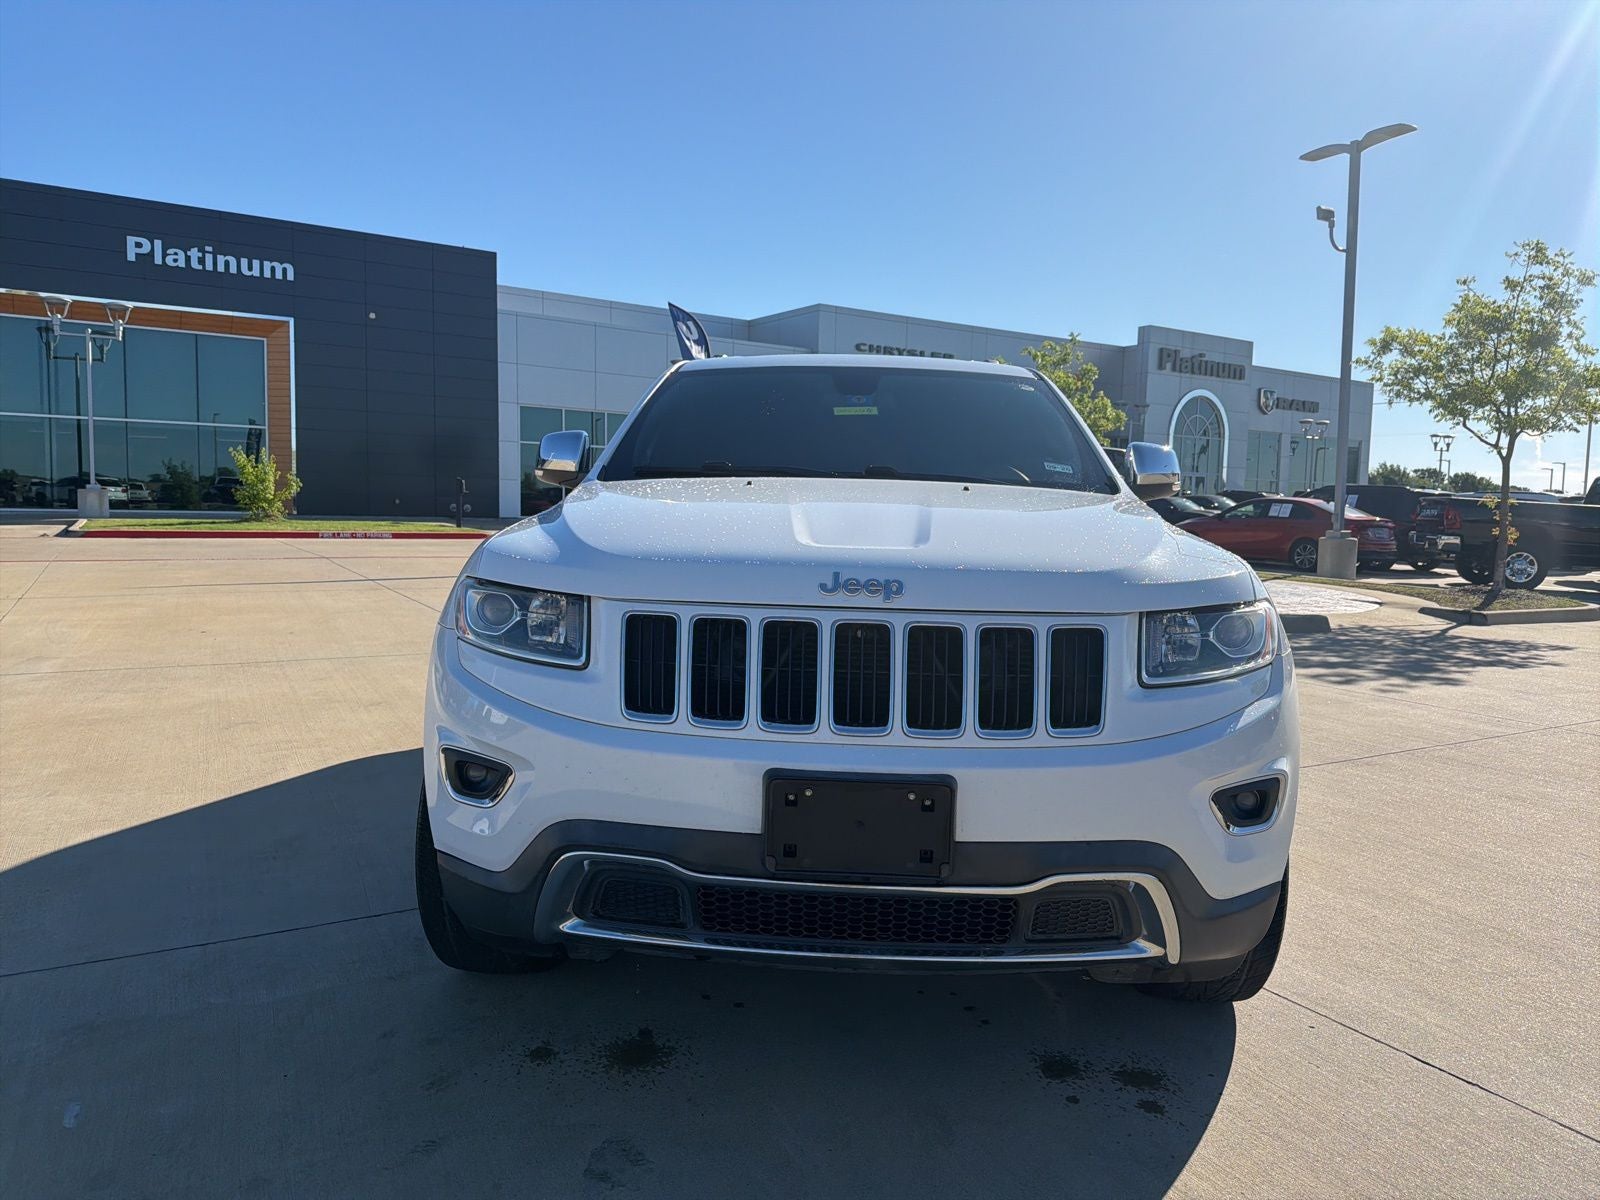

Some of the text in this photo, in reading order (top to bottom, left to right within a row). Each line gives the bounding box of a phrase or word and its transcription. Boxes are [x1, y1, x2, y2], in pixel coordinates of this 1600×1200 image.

[126, 235, 295, 281] Platinum
[1158, 347, 1246, 380] Platinum
[1276, 397, 1320, 413] RAM
[818, 571, 905, 603] Jeep
